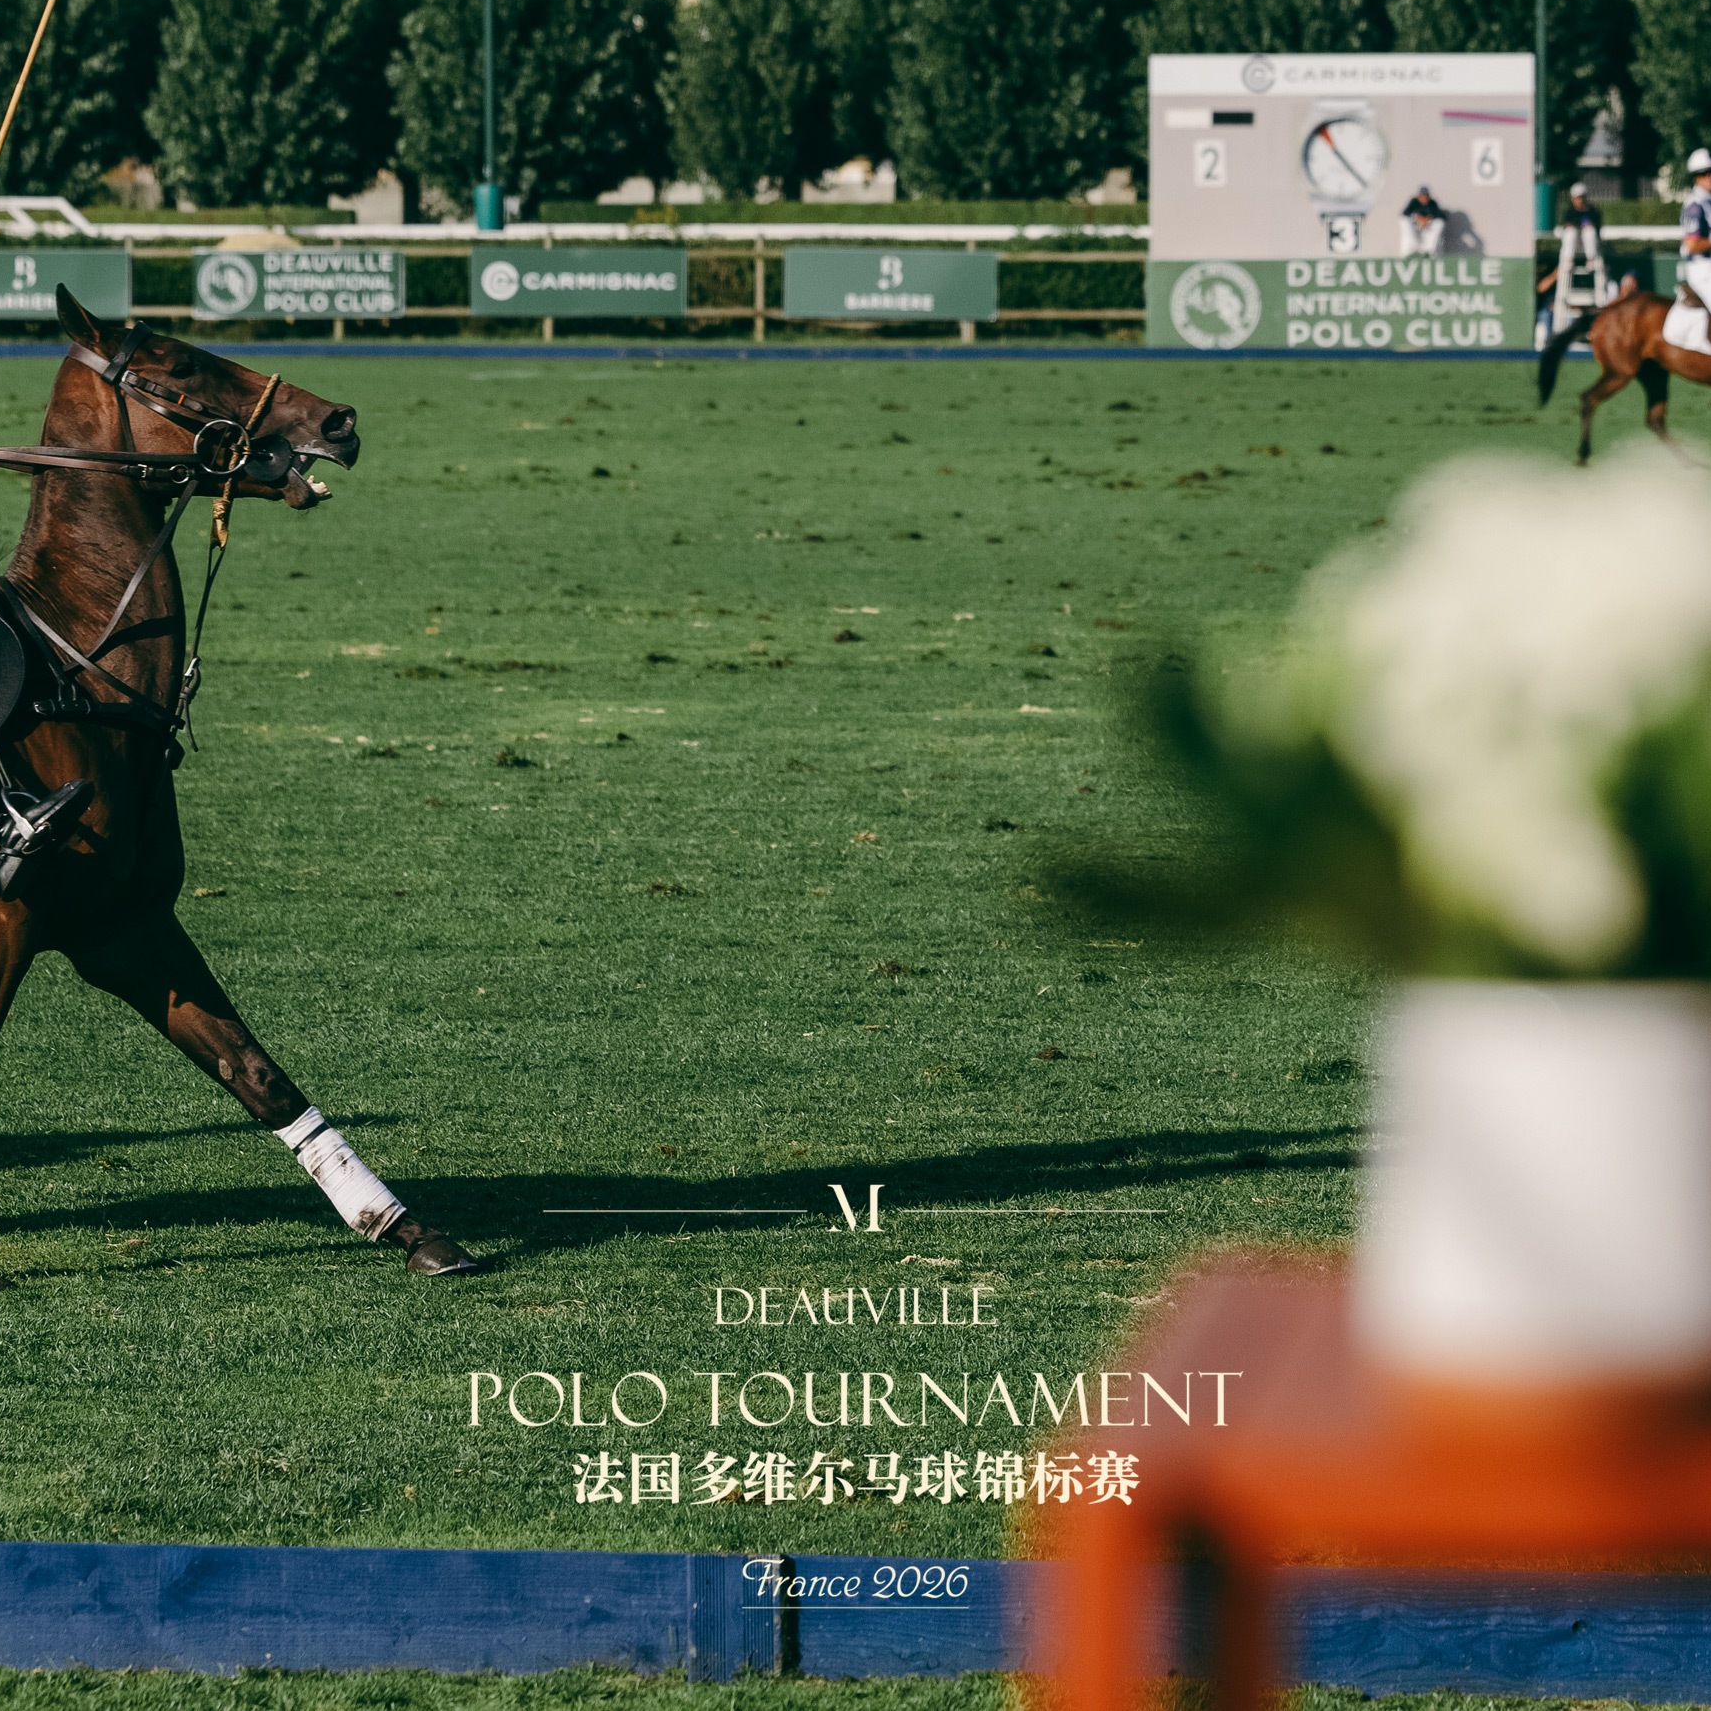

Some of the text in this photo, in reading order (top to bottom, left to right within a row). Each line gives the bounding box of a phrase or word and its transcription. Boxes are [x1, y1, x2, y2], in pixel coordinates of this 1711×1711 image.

[1284, 66, 1444, 83] CARMIGNAC
[1201, 148, 1220, 182] 2
[1477, 148, 1497, 182] 6
[1331, 217, 1356, 252] 3
[264, 252, 393, 272] DEAUVILLE
[264, 272, 393, 292] INTERNATIONAL
[522, 272, 678, 292] CARMIGNAC
[1286, 261, 1503, 287] DEAUVILLE
[264, 292, 395, 312] POLO CLUB
[1286, 292, 1503, 315] INTERNATIONAL
[1286, 320, 1503, 348] POLO CLUB
